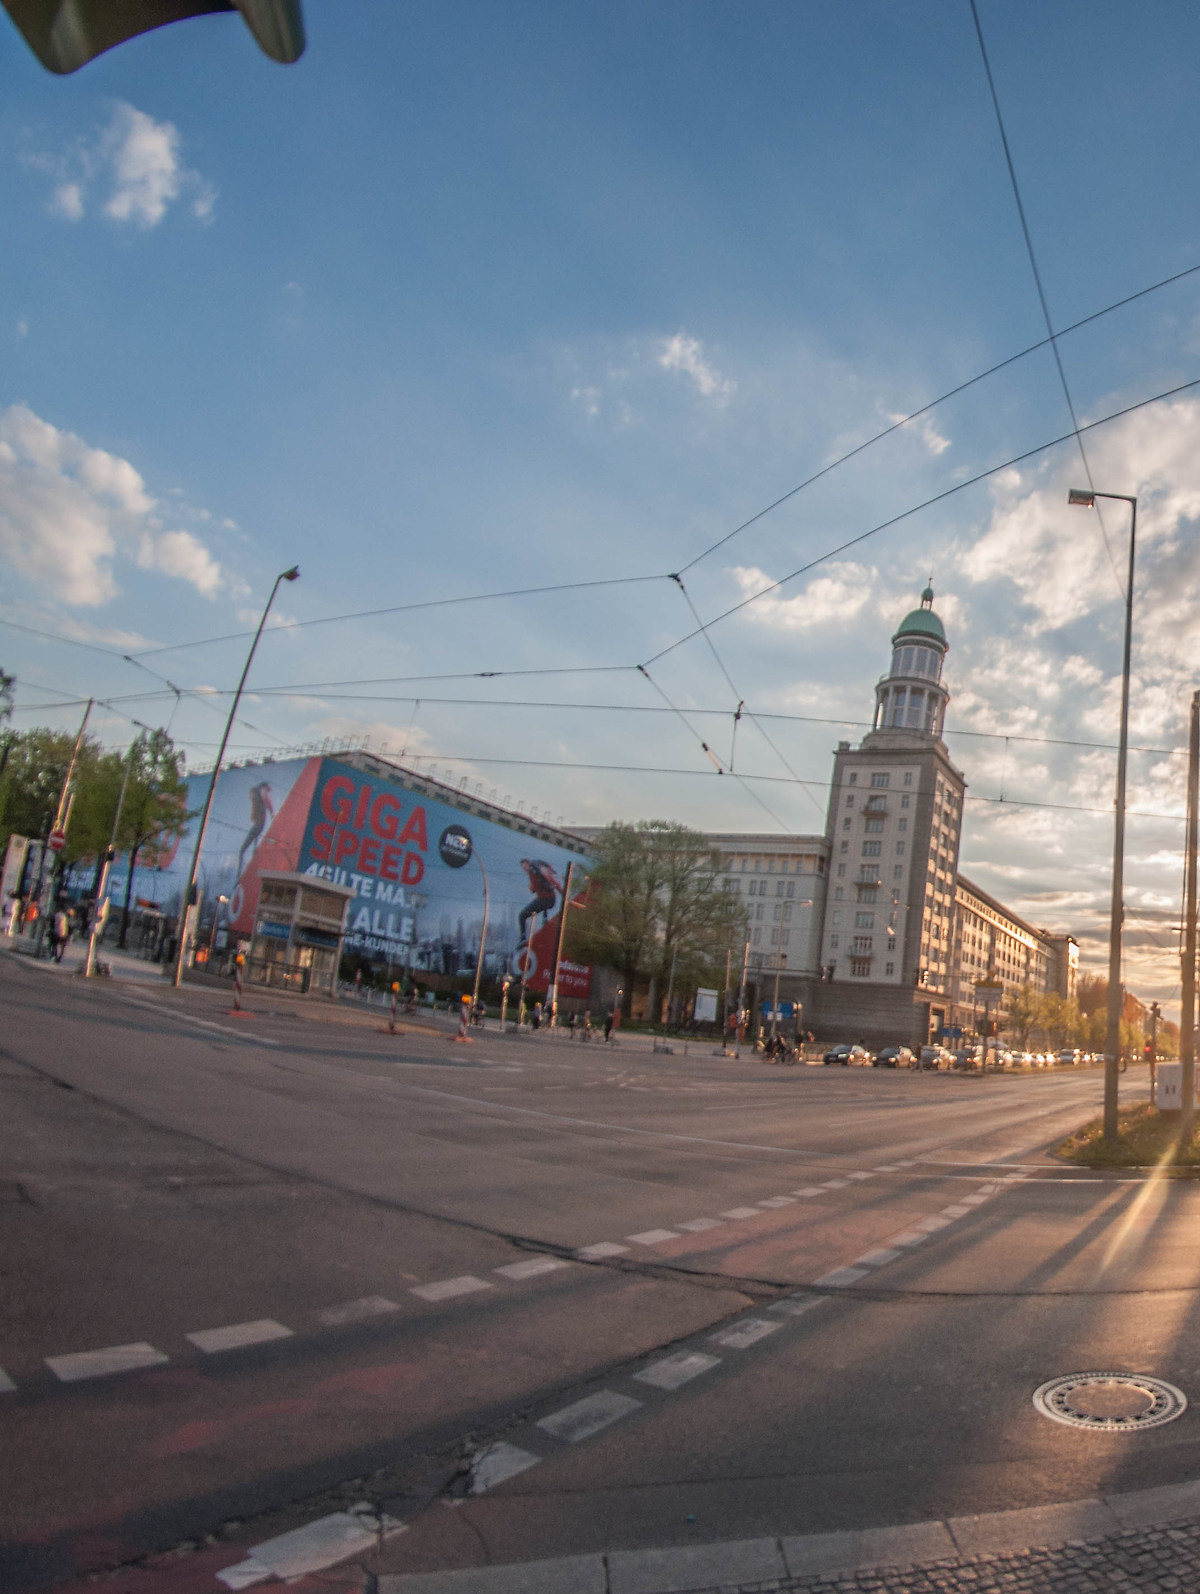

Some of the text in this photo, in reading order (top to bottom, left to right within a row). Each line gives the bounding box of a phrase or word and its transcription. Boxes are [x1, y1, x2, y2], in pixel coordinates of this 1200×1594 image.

[321, 775, 428, 852] GIGA
[310, 822, 425, 885] SPEED
[352, 906, 414, 941] ALLE
